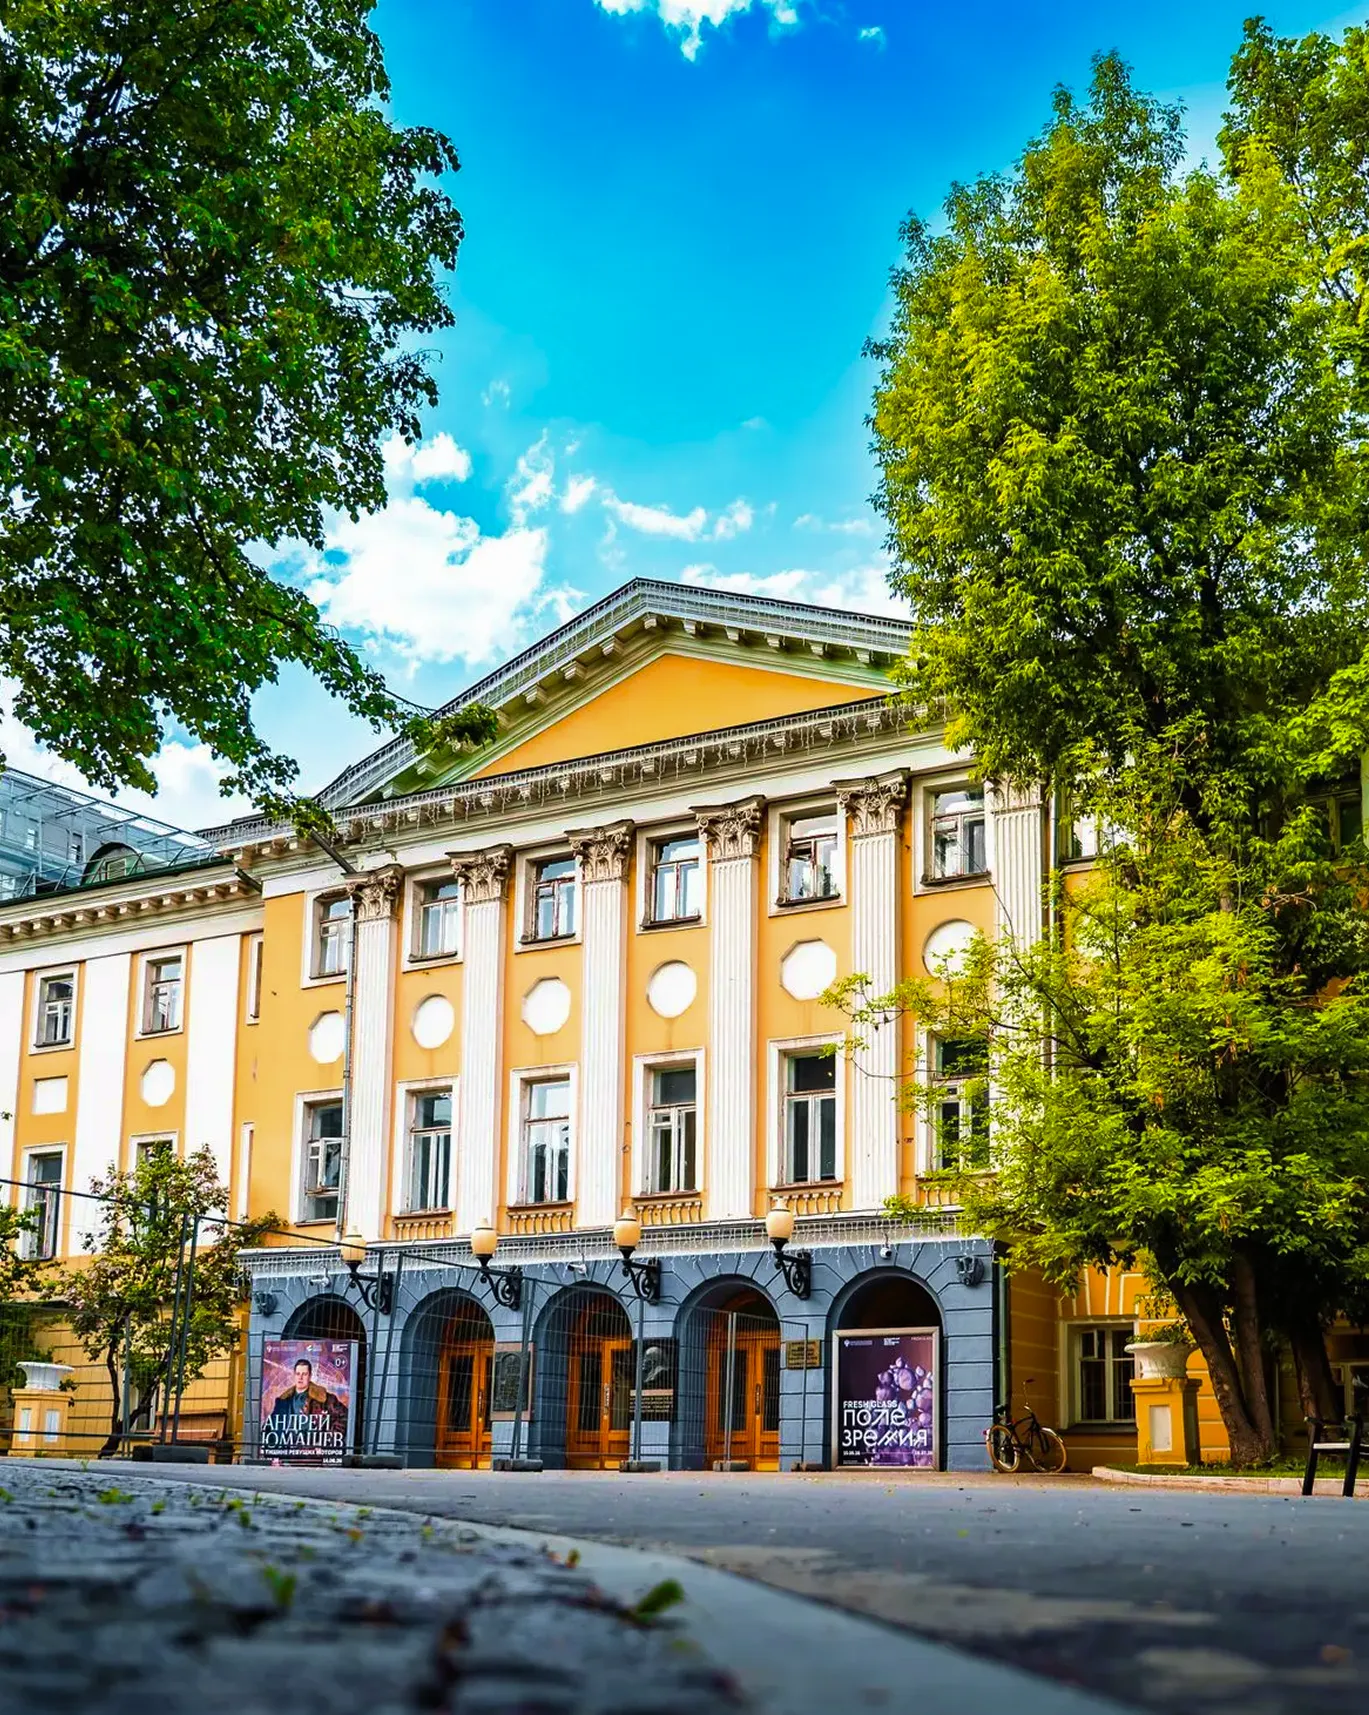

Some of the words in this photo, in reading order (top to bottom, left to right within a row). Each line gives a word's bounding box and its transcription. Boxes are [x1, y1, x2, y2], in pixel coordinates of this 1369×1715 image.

[335, 1358, 346, 1367] 0+
[843, 1400, 868, 1409] FRESH
[870, 1400, 898, 1408] GLASS
[262, 1410, 332, 1434] АНДРЕЙ
[261, 1431, 344, 1448] ЮМАШЕВ
